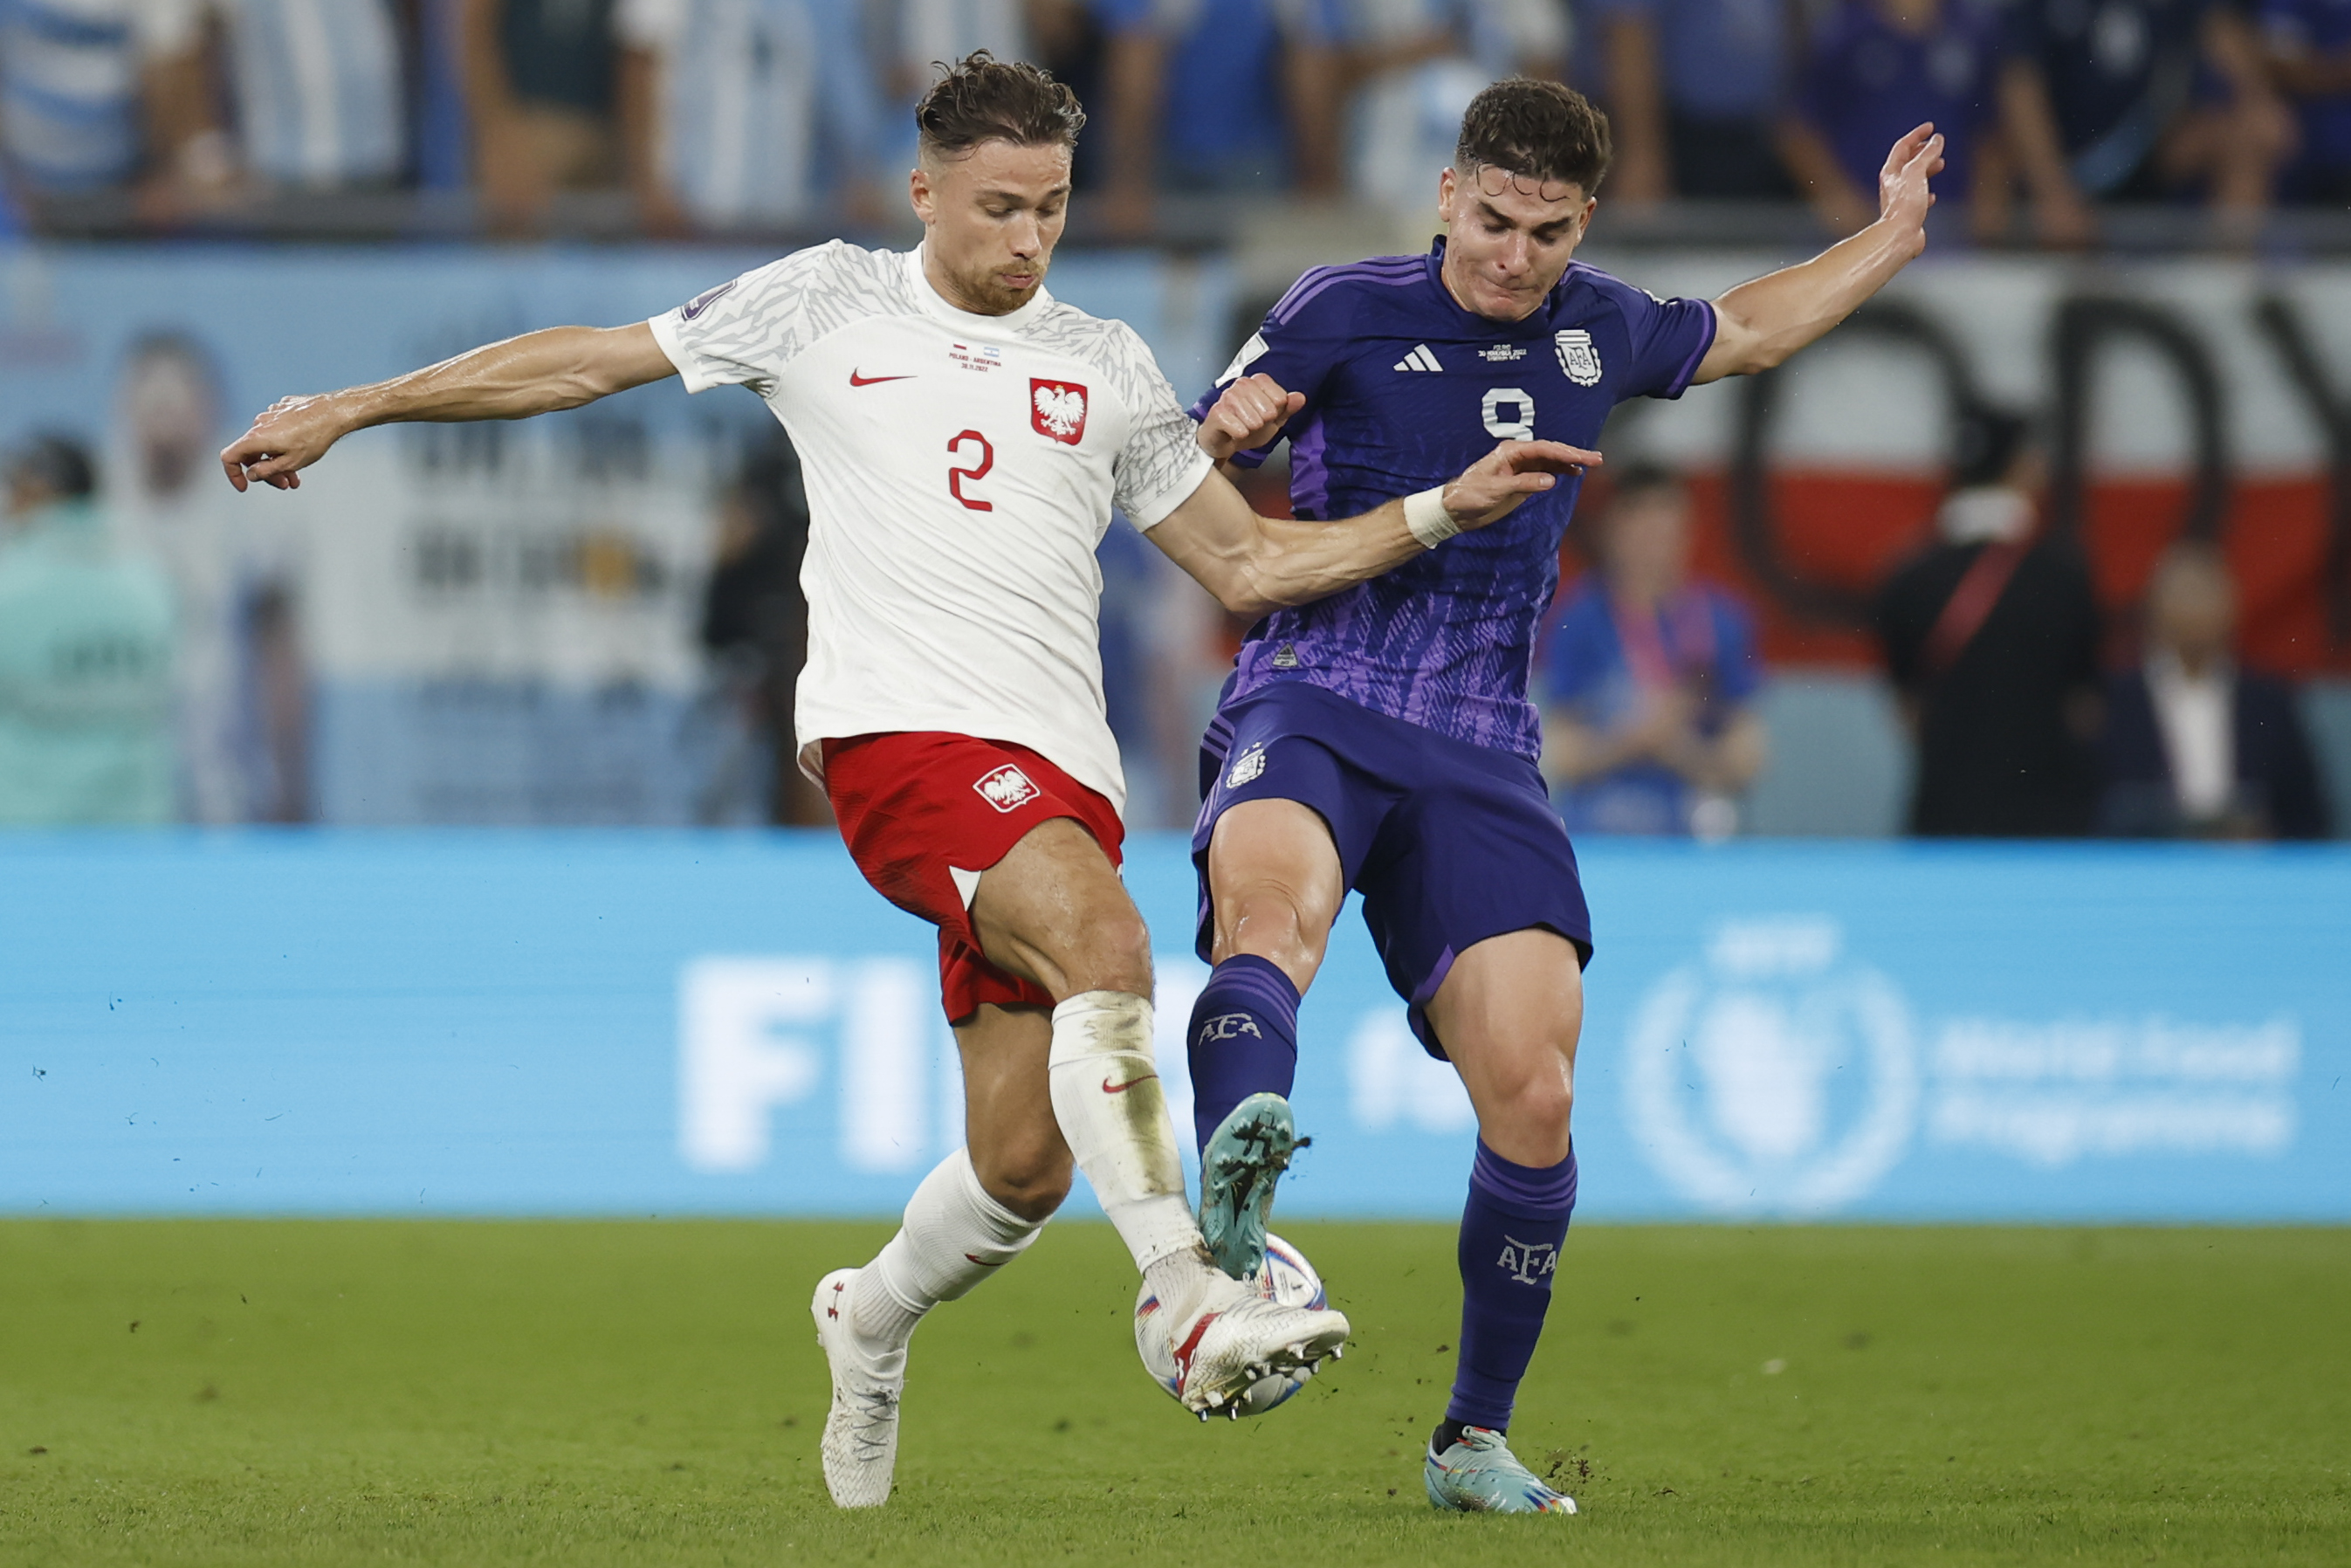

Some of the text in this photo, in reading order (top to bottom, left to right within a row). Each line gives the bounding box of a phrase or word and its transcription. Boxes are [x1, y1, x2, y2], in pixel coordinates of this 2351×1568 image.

[949, 352, 969, 361] POLAND
[973, 357, 1001, 367] ARGENTINA
[1481, 388, 1535, 442] 9
[947, 430, 993, 512] 2
[1199, 1013, 1262, 1047] AFA
[1496, 1234, 1557, 1285] AFA
